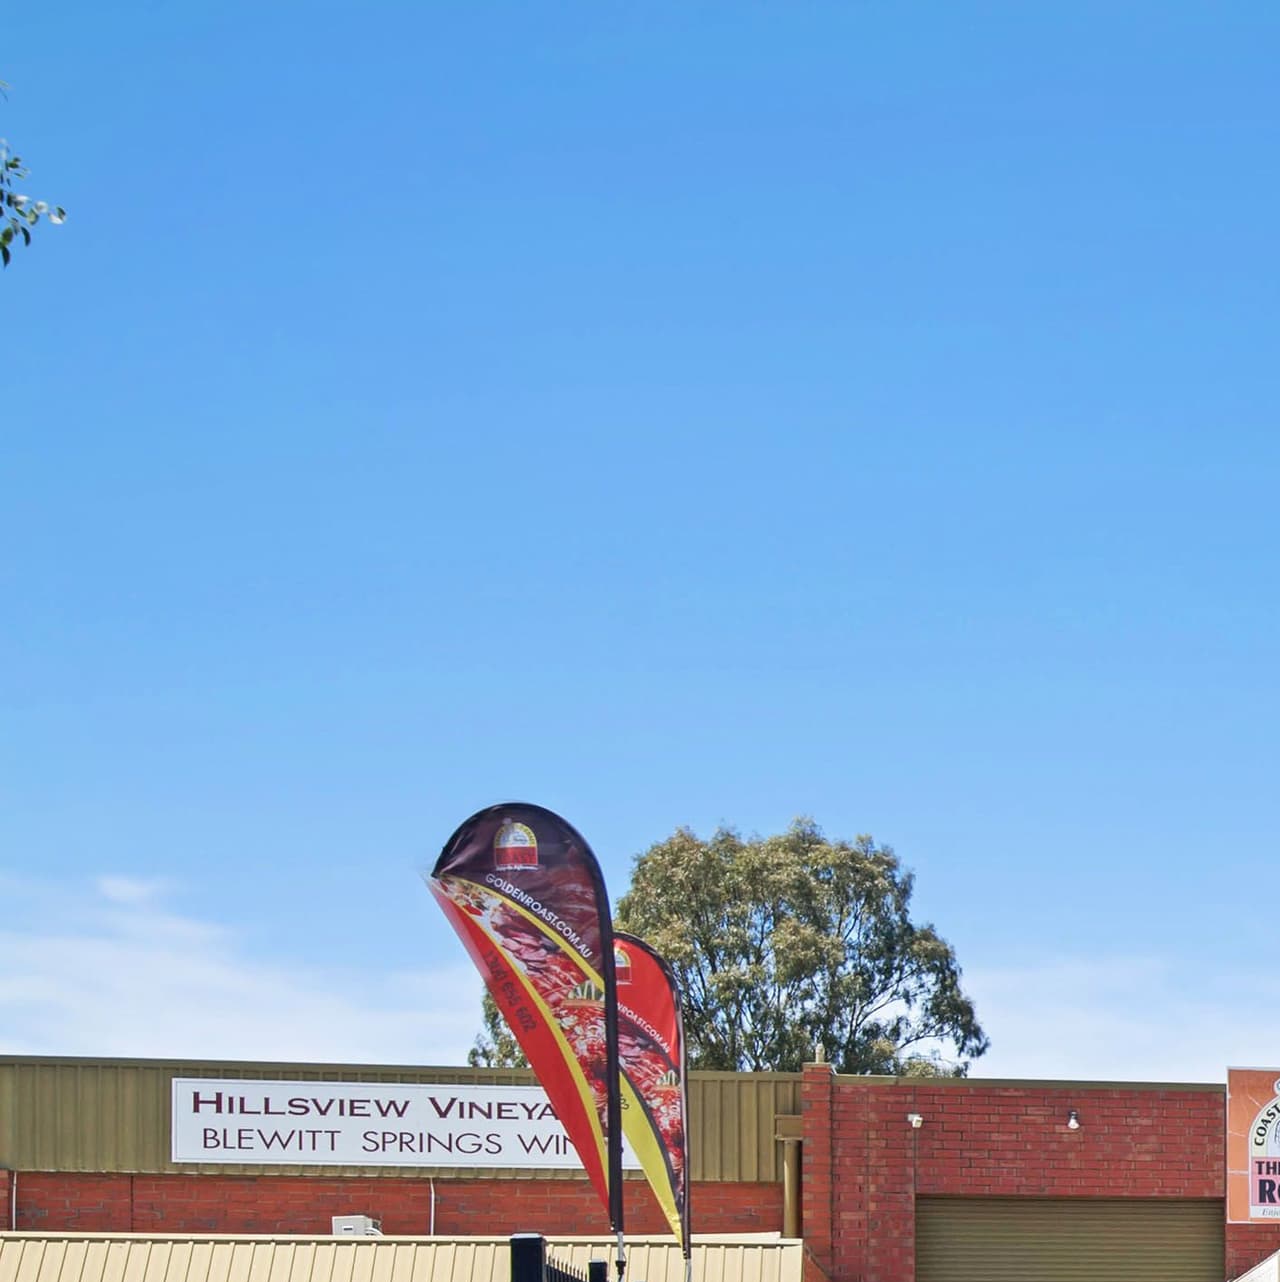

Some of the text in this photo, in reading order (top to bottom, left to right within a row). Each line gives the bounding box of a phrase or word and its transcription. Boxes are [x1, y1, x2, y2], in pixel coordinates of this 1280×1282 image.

[485, 873, 593, 959] GOLDENROAST.COM.AU
[192, 1091, 560, 1120] HILLSVIEW VINEYA
[203, 1128, 341, 1151] BLEWITT
[362, 1131, 502, 1155] SPRINGS
